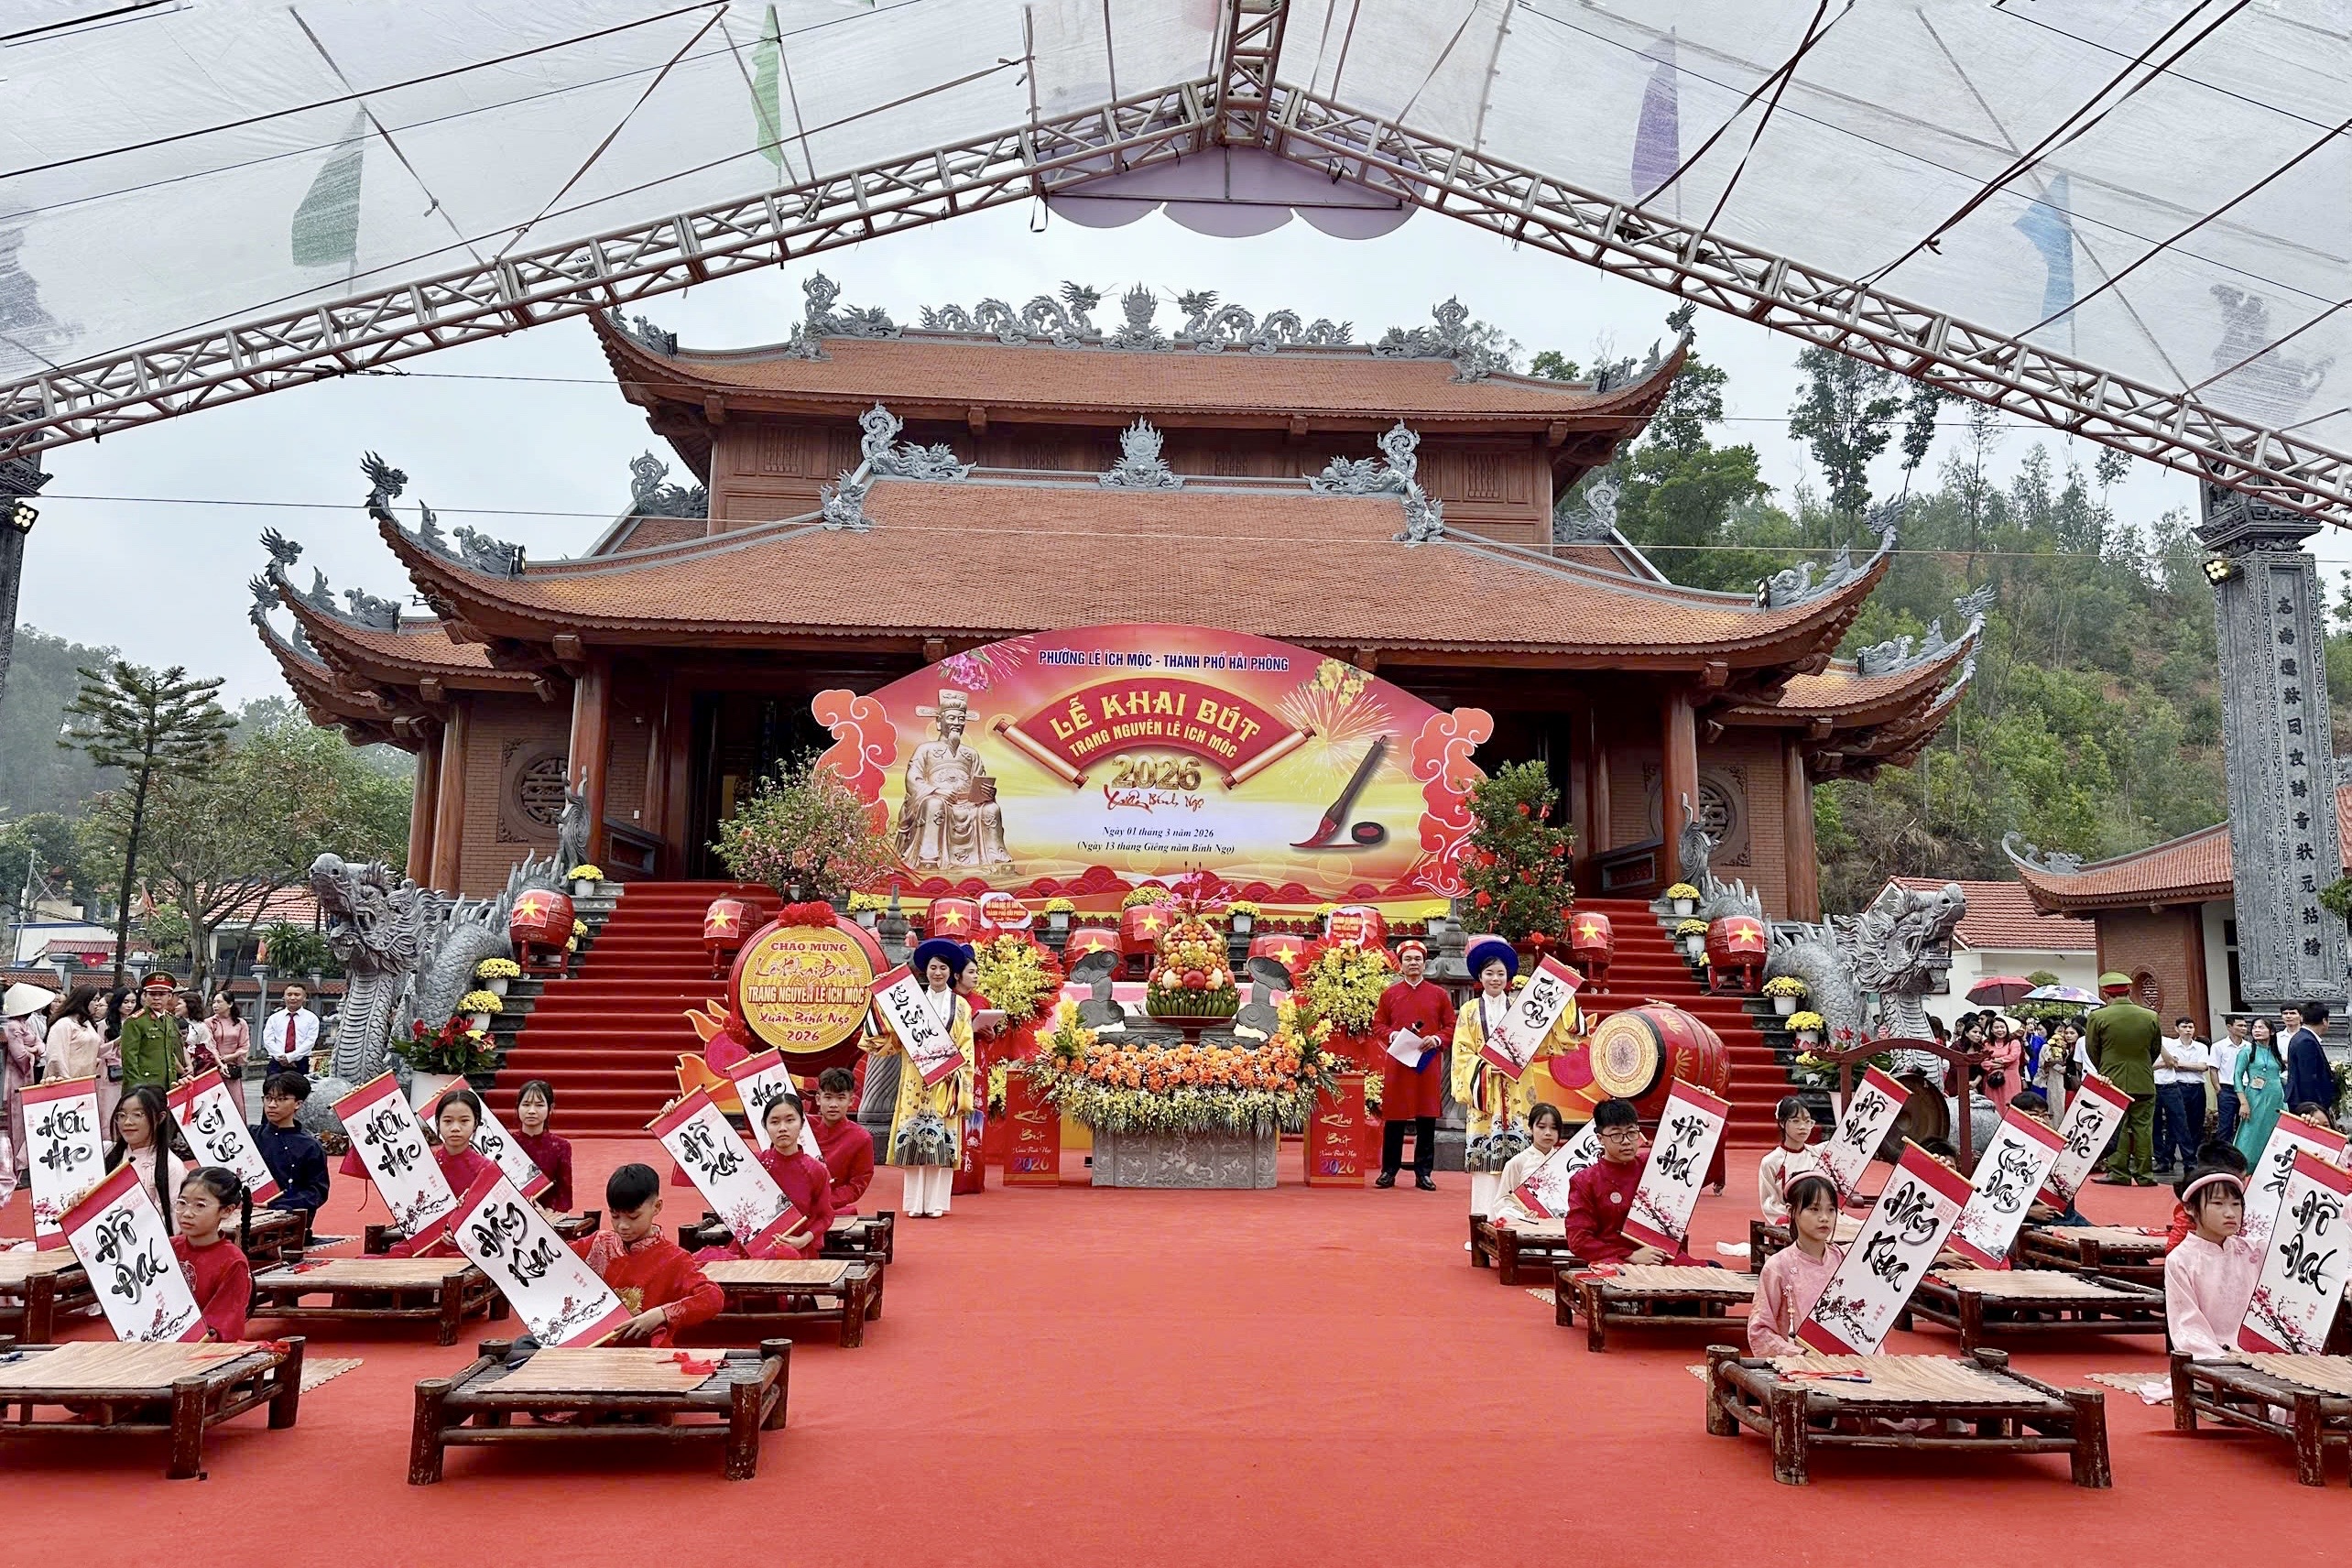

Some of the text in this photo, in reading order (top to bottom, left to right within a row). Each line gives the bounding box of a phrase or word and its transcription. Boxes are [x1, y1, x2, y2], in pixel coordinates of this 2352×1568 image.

[1039, 648, 1085, 665] PHƯỜNG
[1089, 649, 1101, 666] LÊ
[1105, 648, 1124, 666] ÍCH
[1127, 650, 1152, 670] MỘC
[1163, 651, 1200, 669] THÀNH
[1203, 650, 1225, 670] PHỐ
[1228, 652, 1247, 670] HẢI
[1250, 653, 1289, 671] PHÒNG
[1050, 691, 1260, 743] LỄ KHAI BÚT
[1069, 719, 1238, 758] TRẠNG NGUYÊN LÊ ÍCH MỘC
[1111, 754, 1202, 790] 2026
[1103, 826, 1214, 838] Ngày 01 tháng 3 năm 2026
[1077, 841, 1235, 855] (Ngày 13 tháng Giêng năm Bính Ngọ)
[747, 985, 777, 1007] TRẠNG
[844, 984, 866, 1007] MỘC
[787, 1030, 820, 1041] 2026
[1012, 1156, 1050, 1172] 2026
[1320, 1160, 1356, 1175] 2026
